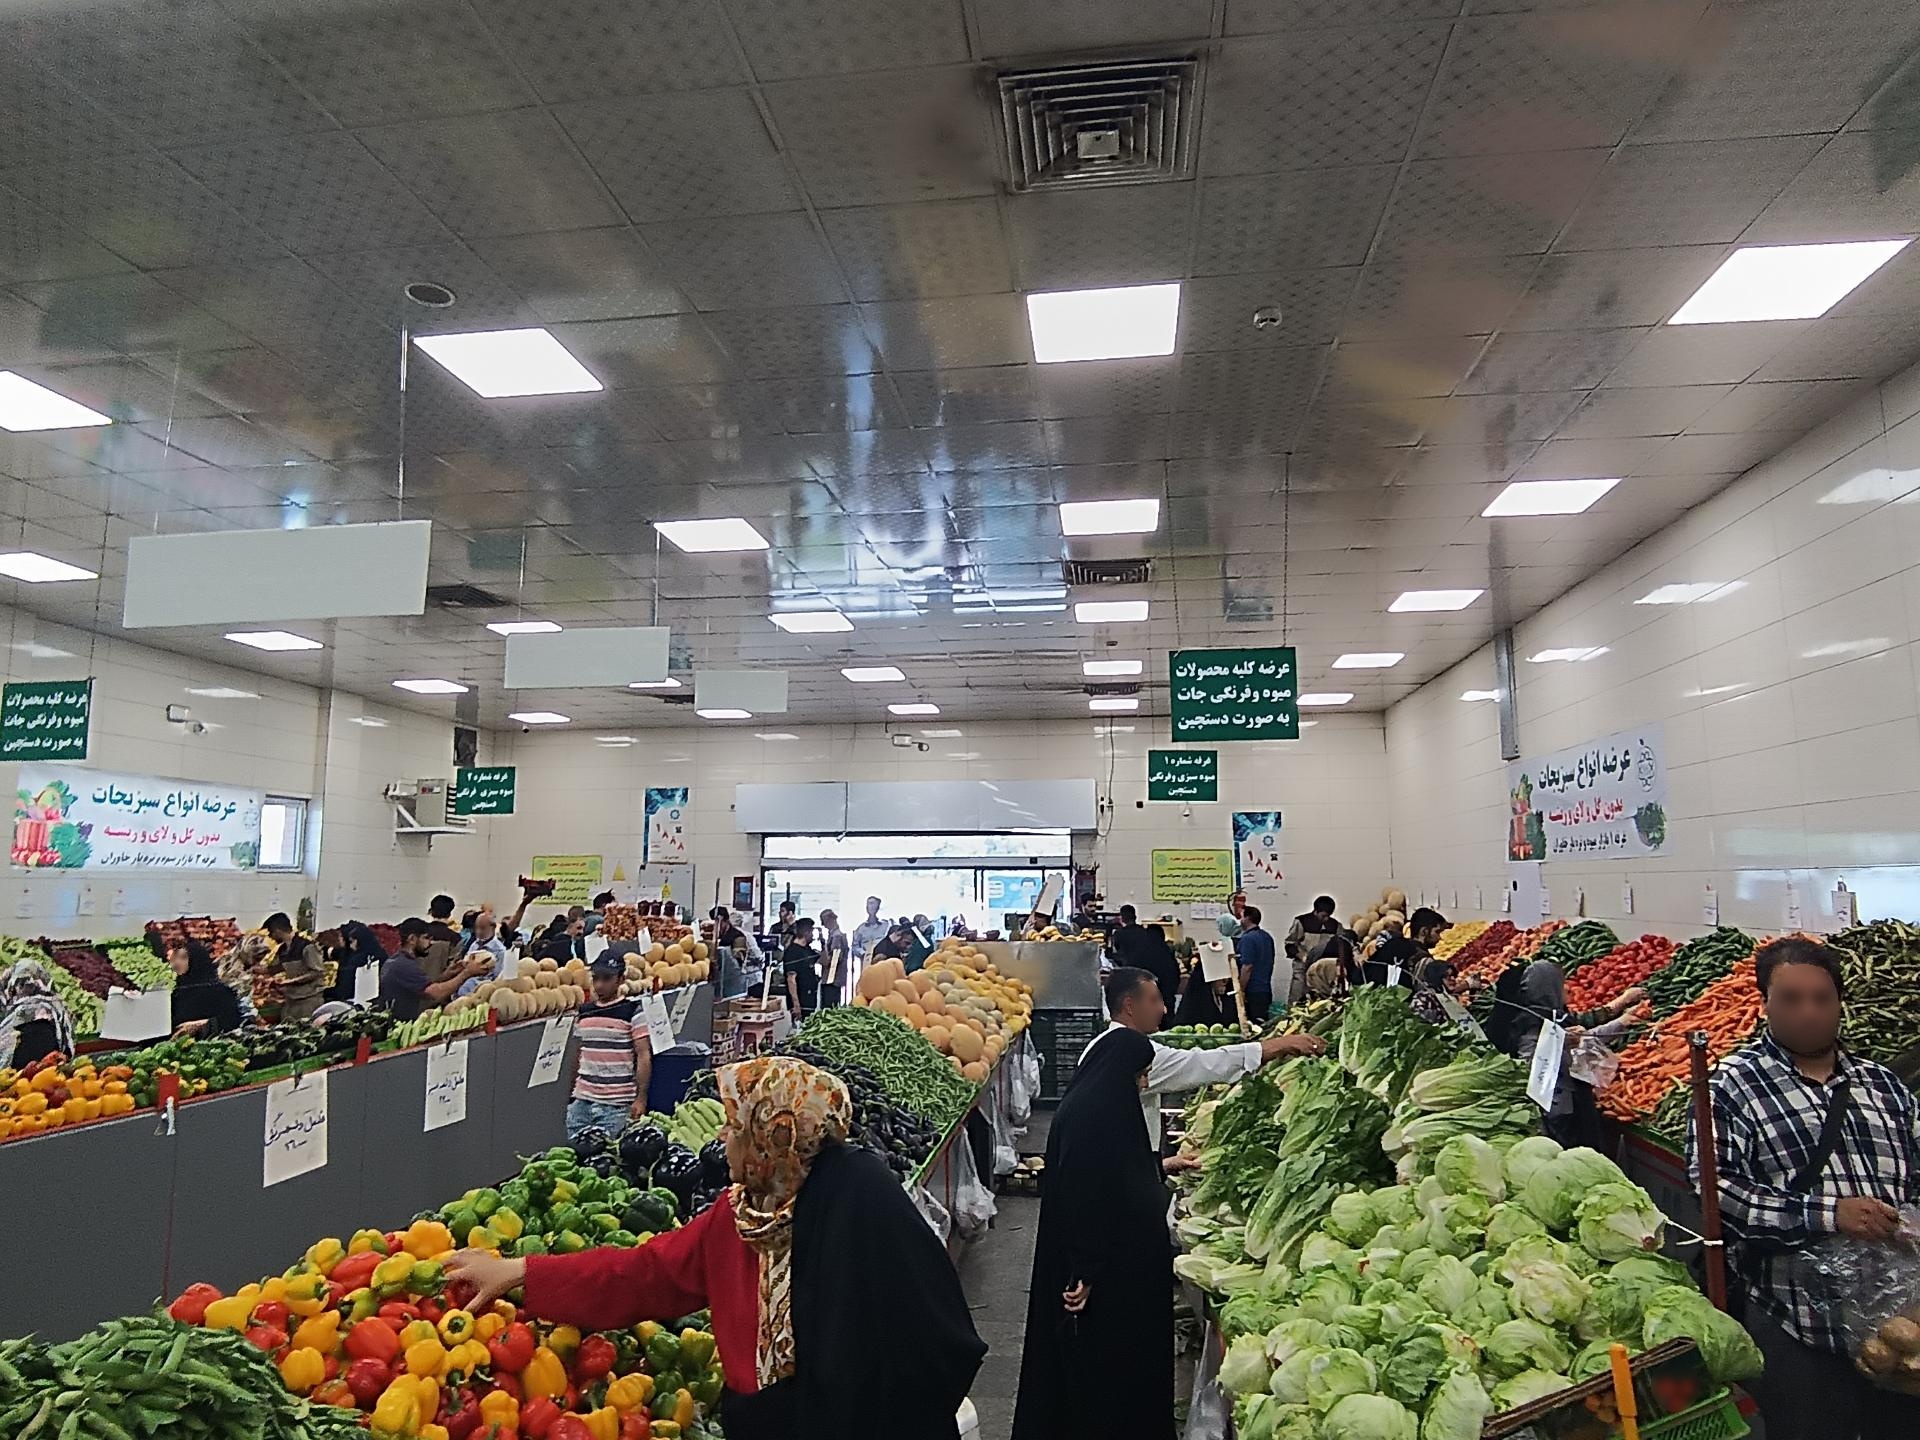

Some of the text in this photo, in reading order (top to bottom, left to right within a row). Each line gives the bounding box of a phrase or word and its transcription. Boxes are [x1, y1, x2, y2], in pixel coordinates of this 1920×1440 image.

[1175, 660, 1290, 681] عرضه کلیه محصولات
[6, 691, 88, 711] عرضه کلیه محصولات
[1177, 686, 1207, 704] جات
[1262, 688, 1292, 703] میوه
[4, 713, 26, 730] جات
[63, 715, 85, 729] میوه
[1177, 713, 1290, 730] به صورت دستچین
[3, 736, 84, 753] به صورت دستچین
[1164, 755, 1211, 768] غرفه شماره ۱
[1538, 746, 1631, 793] عرضه انواع سبزیجات
[473, 771, 492, 784] شماره
[1177, 773, 1198, 783] سبزی
[1199, 774, 1216, 783] میوه
[1167, 786, 1198, 797] دستچین
[92, 783, 237, 821] عرضه انواع سبزیجات
[140, 830, 148, 843] و
[171, 832, 177, 845] و
